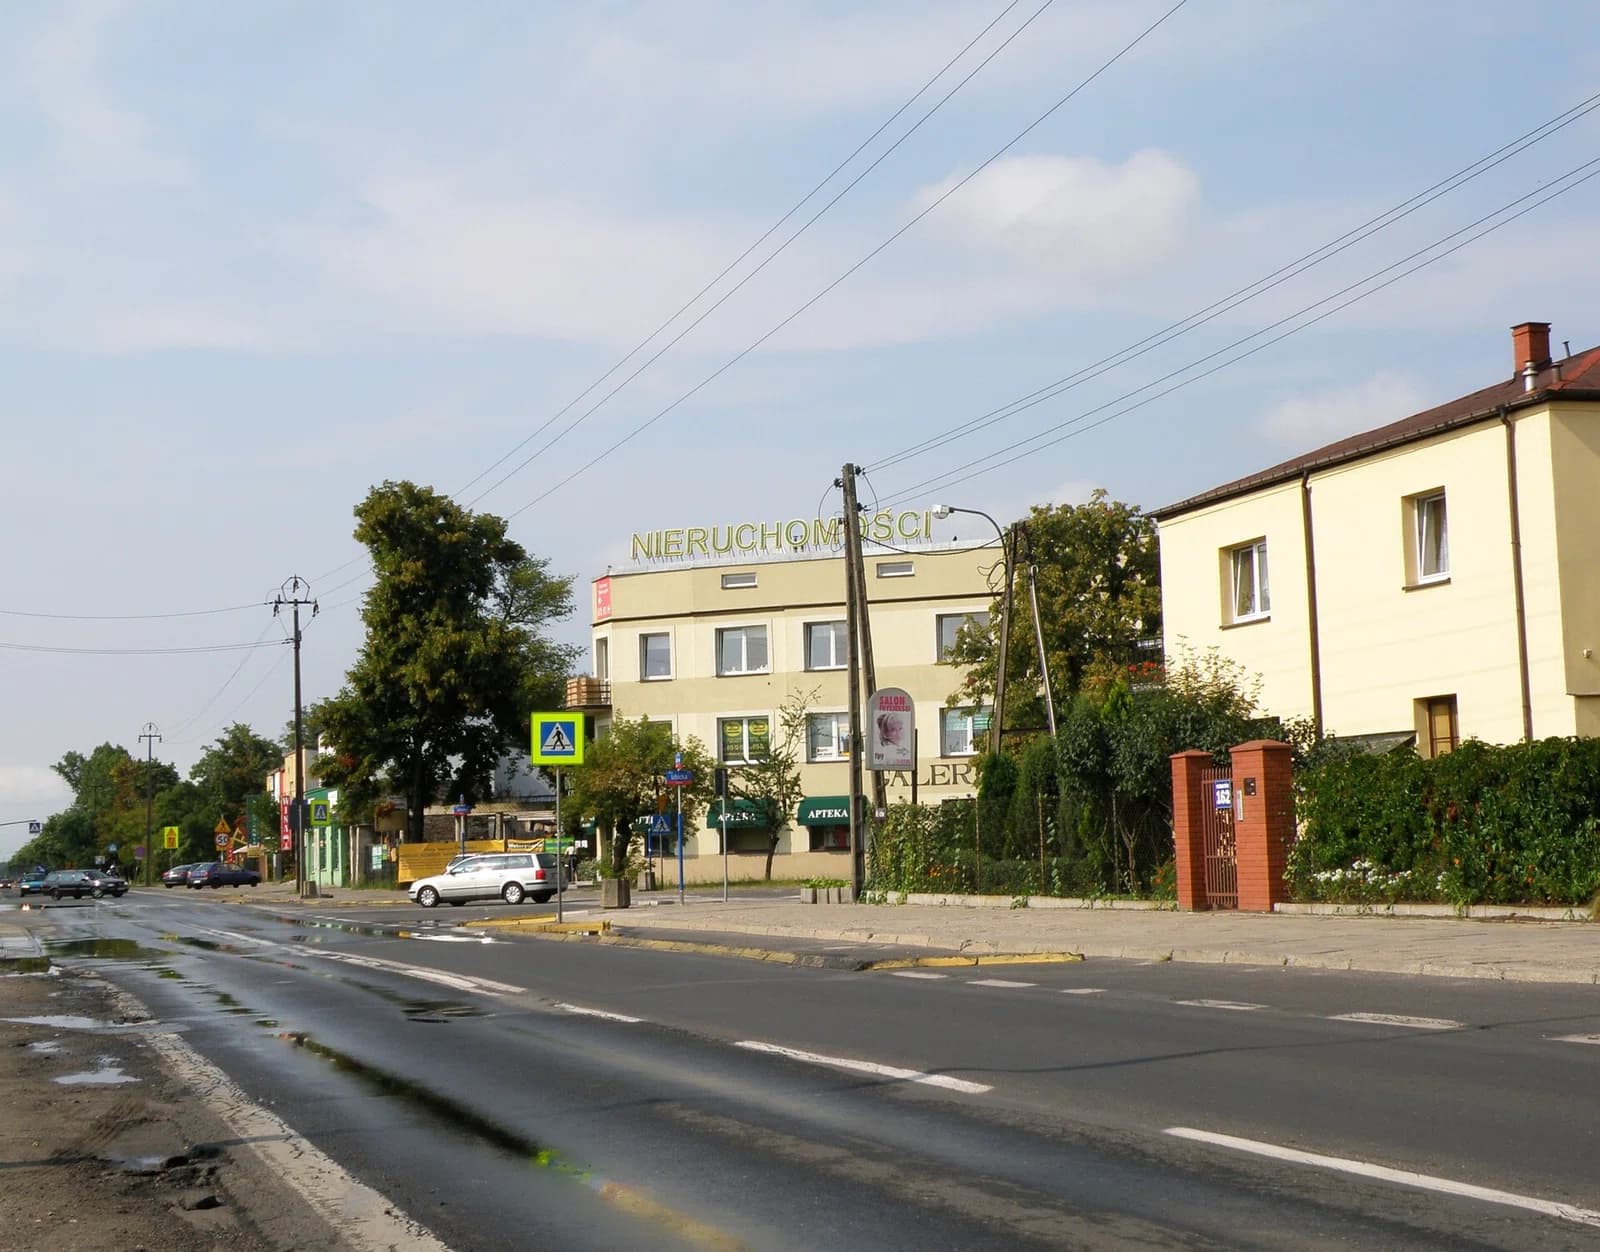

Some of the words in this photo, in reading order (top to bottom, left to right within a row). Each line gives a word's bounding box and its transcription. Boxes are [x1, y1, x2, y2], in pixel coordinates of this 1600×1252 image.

[880, 696, 905, 705] SALON
[884, 763, 974, 787] ALER
[1216, 789, 1231, 805] 162
[718, 812, 757, 822] APEK
[808, 809, 848, 819] APTEKA
[217, 836, 228, 845] 50
